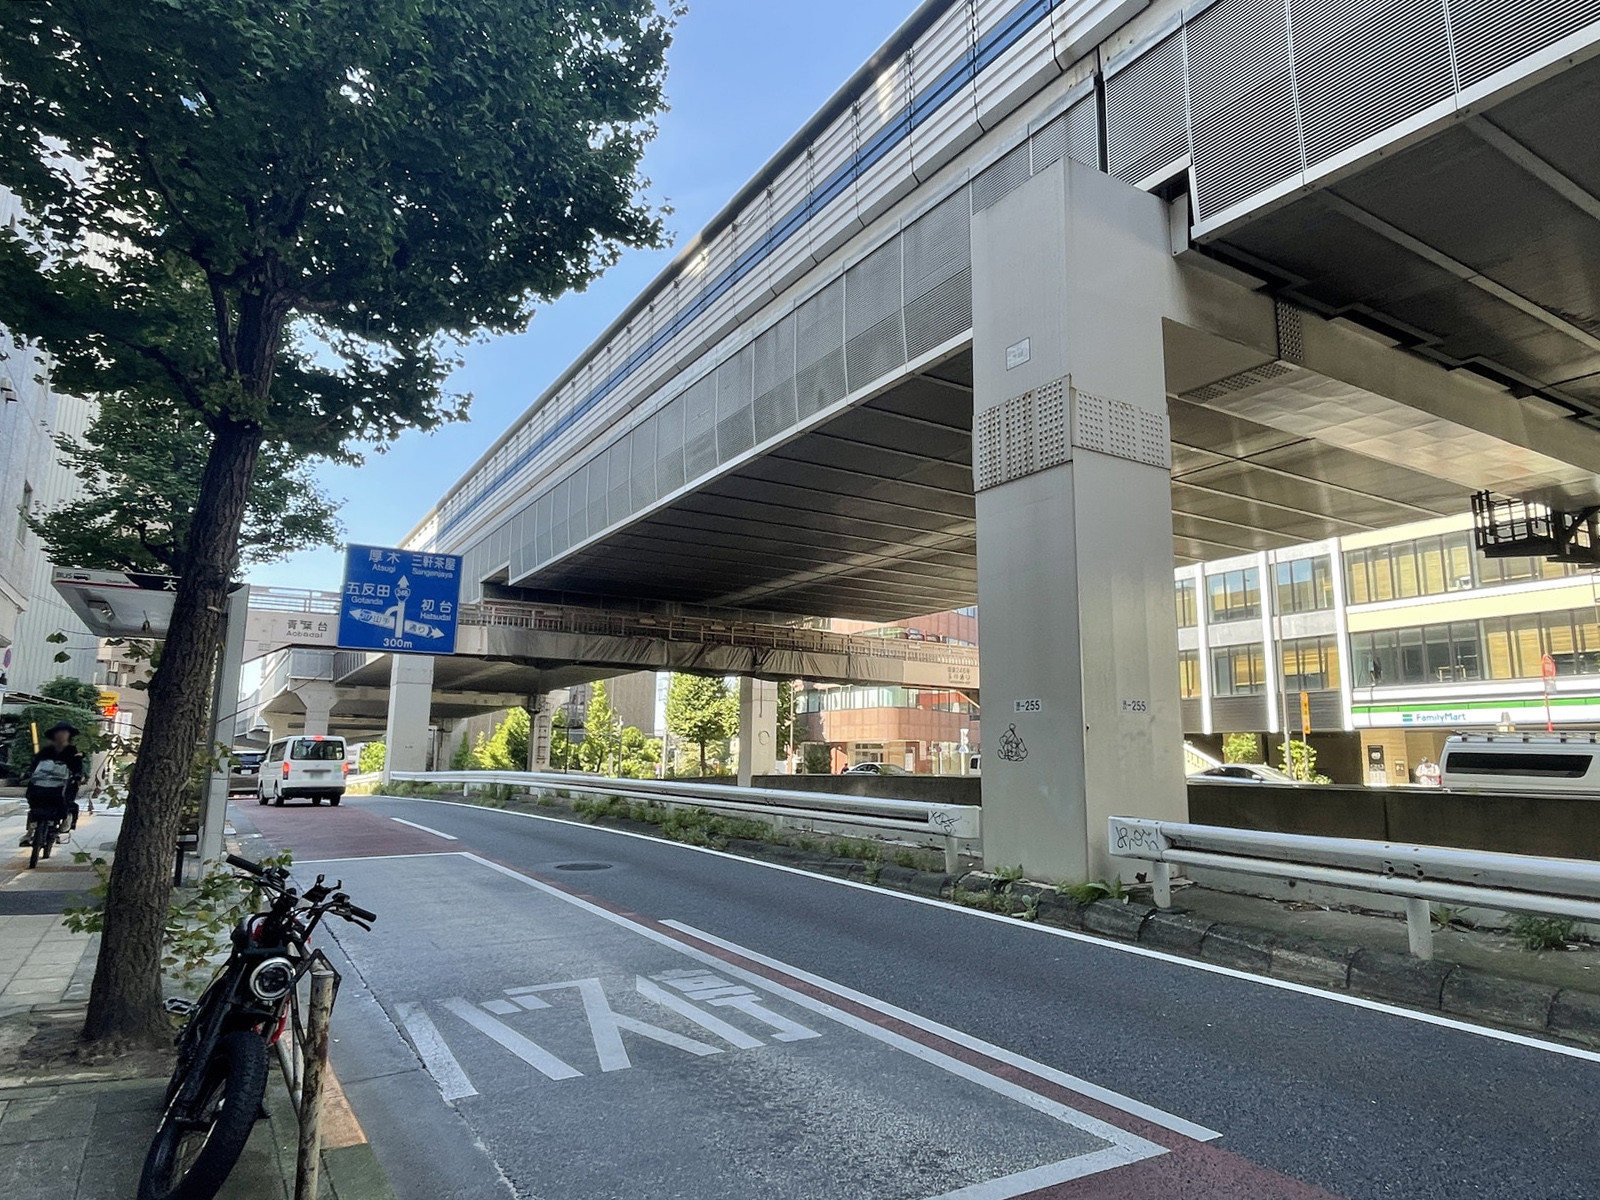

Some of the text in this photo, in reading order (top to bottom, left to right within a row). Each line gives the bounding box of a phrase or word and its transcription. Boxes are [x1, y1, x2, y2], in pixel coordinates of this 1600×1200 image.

[368, 549, 401, 564] 厚木
[411, 554, 456, 571] 三軒茶屋
[371, 563, 396, 574] Atsugi
[411, 567, 454, 579] Sangenjaya
[56, 571, 72, 579] BUS
[346, 581, 391, 598] 五反田
[351, 595, 383, 606] Gotanda
[420, 599, 453, 613] 初台
[420, 612, 451, 621] Hatsudai
[287, 619, 328, 632] 青葉台
[286, 630, 323, 638] Aobadai
[383, 638, 413, 648] 300m
[1415, 713, 1466, 722] FamilyMart
[394, 969, 822, 1101] バス停
